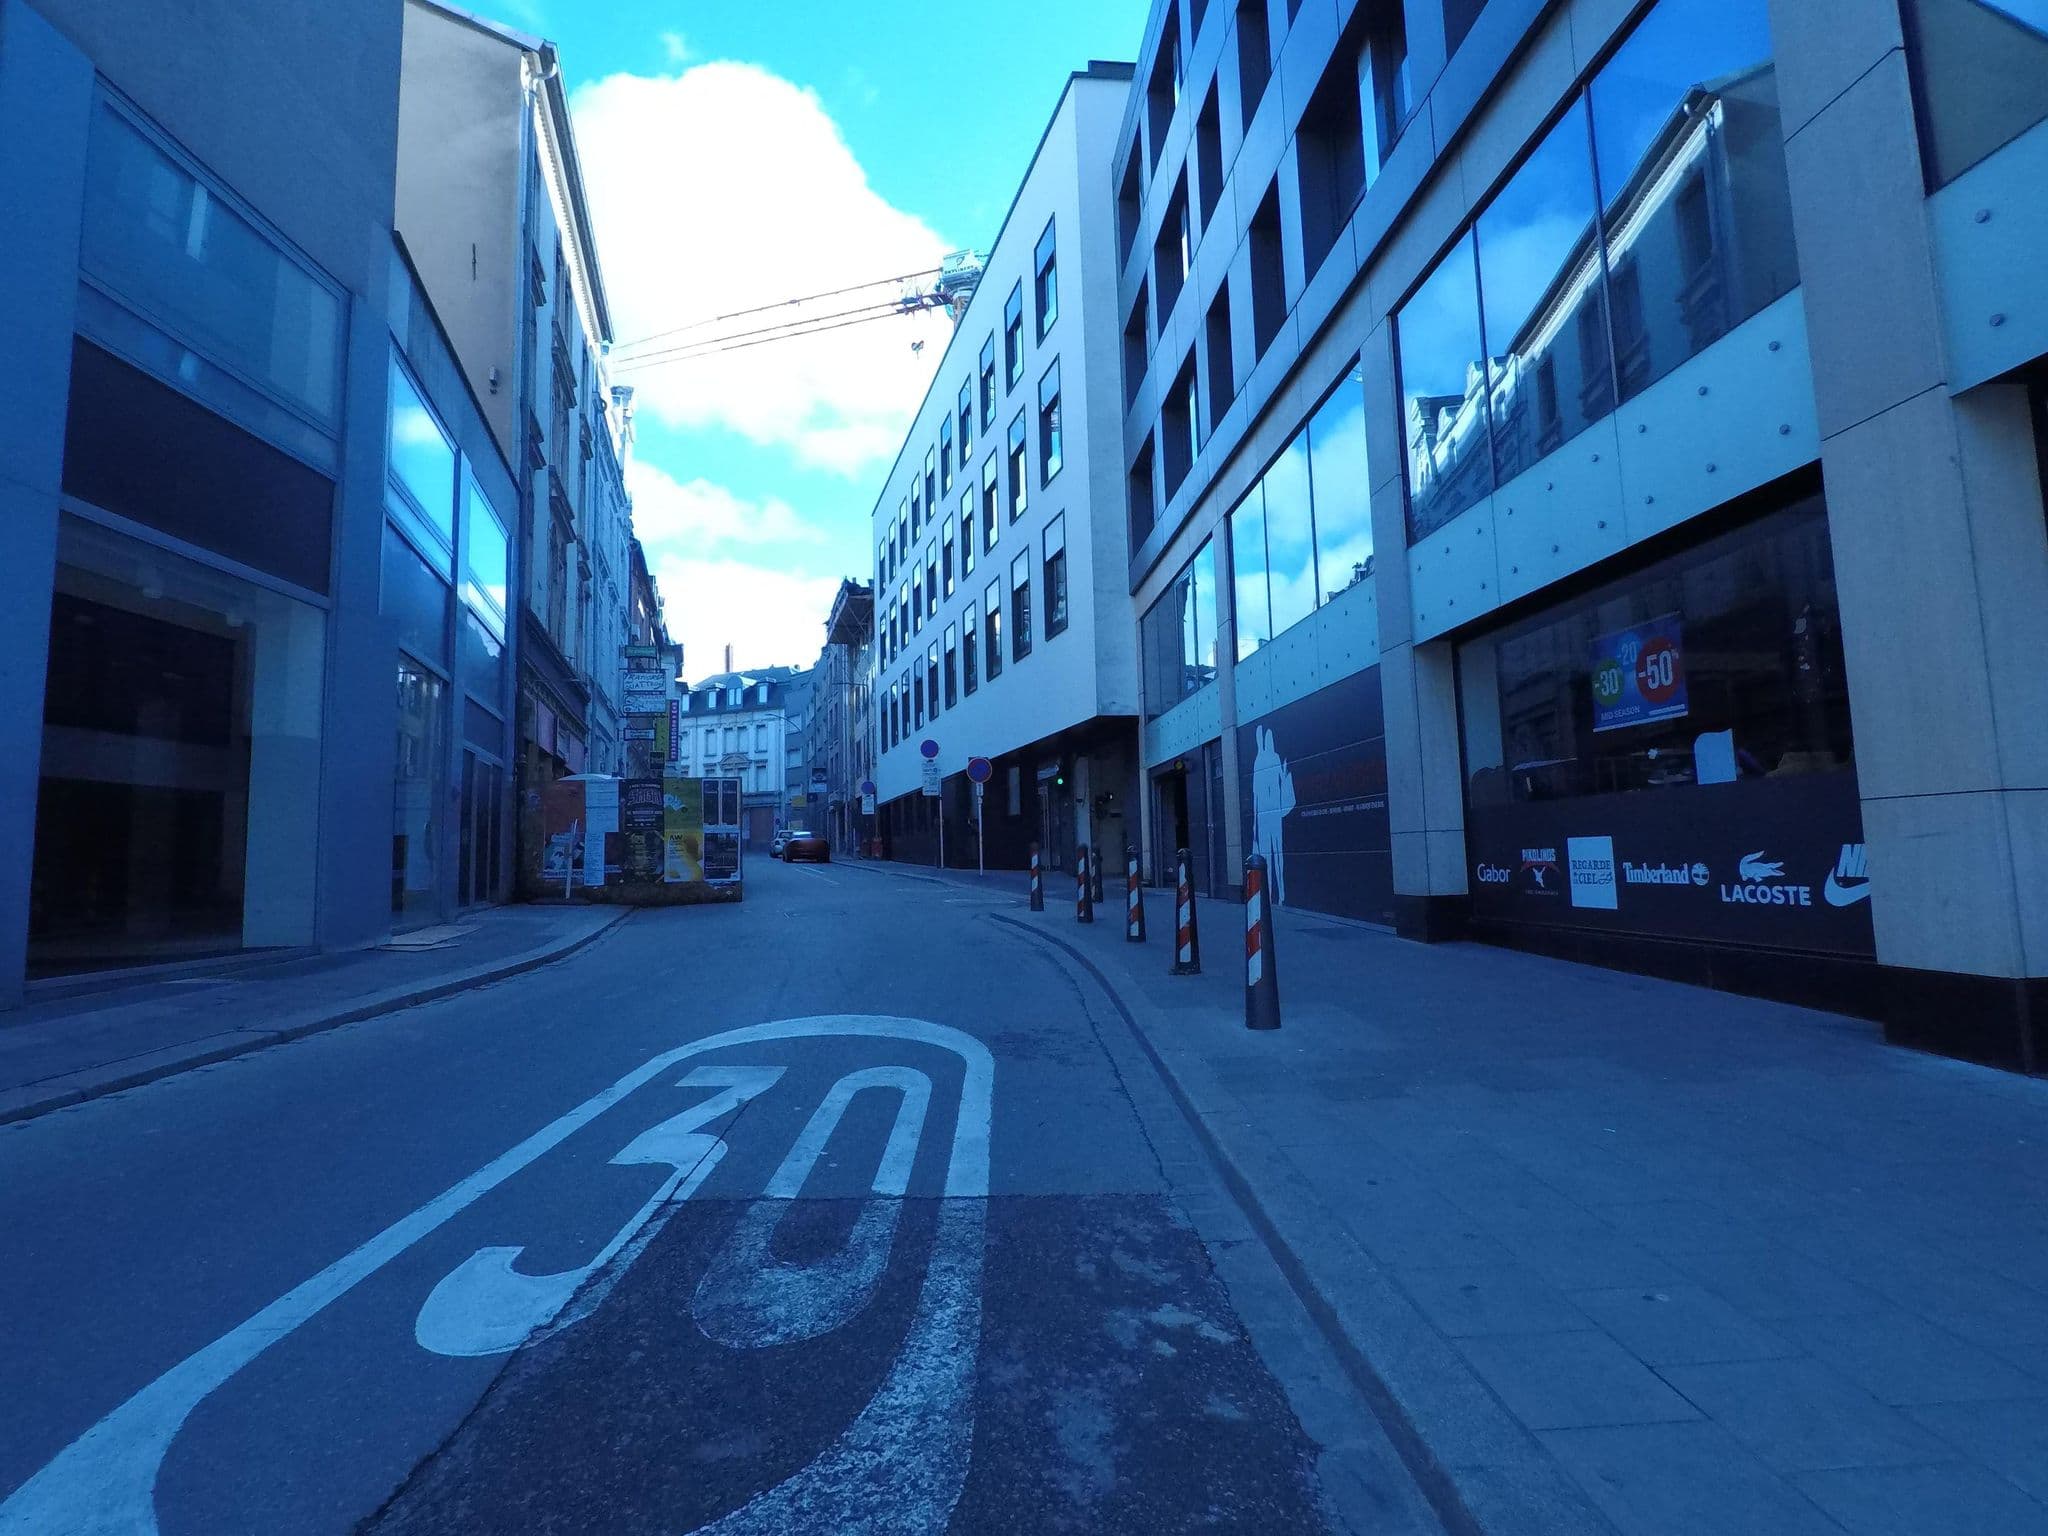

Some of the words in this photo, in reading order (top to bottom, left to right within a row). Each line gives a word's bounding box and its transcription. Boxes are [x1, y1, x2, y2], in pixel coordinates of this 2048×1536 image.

[1571, 860, 1611, 870] REGARDE
[1836, 844, 1870, 878] NI
[1476, 863, 1511, 883] Gabor
[1578, 873, 1598, 885] CIEL
[1622, 862, 1690, 885] Timberland
[1720, 884, 1812, 906] LACOSTE
[415, 1064, 933, 1358] 30
